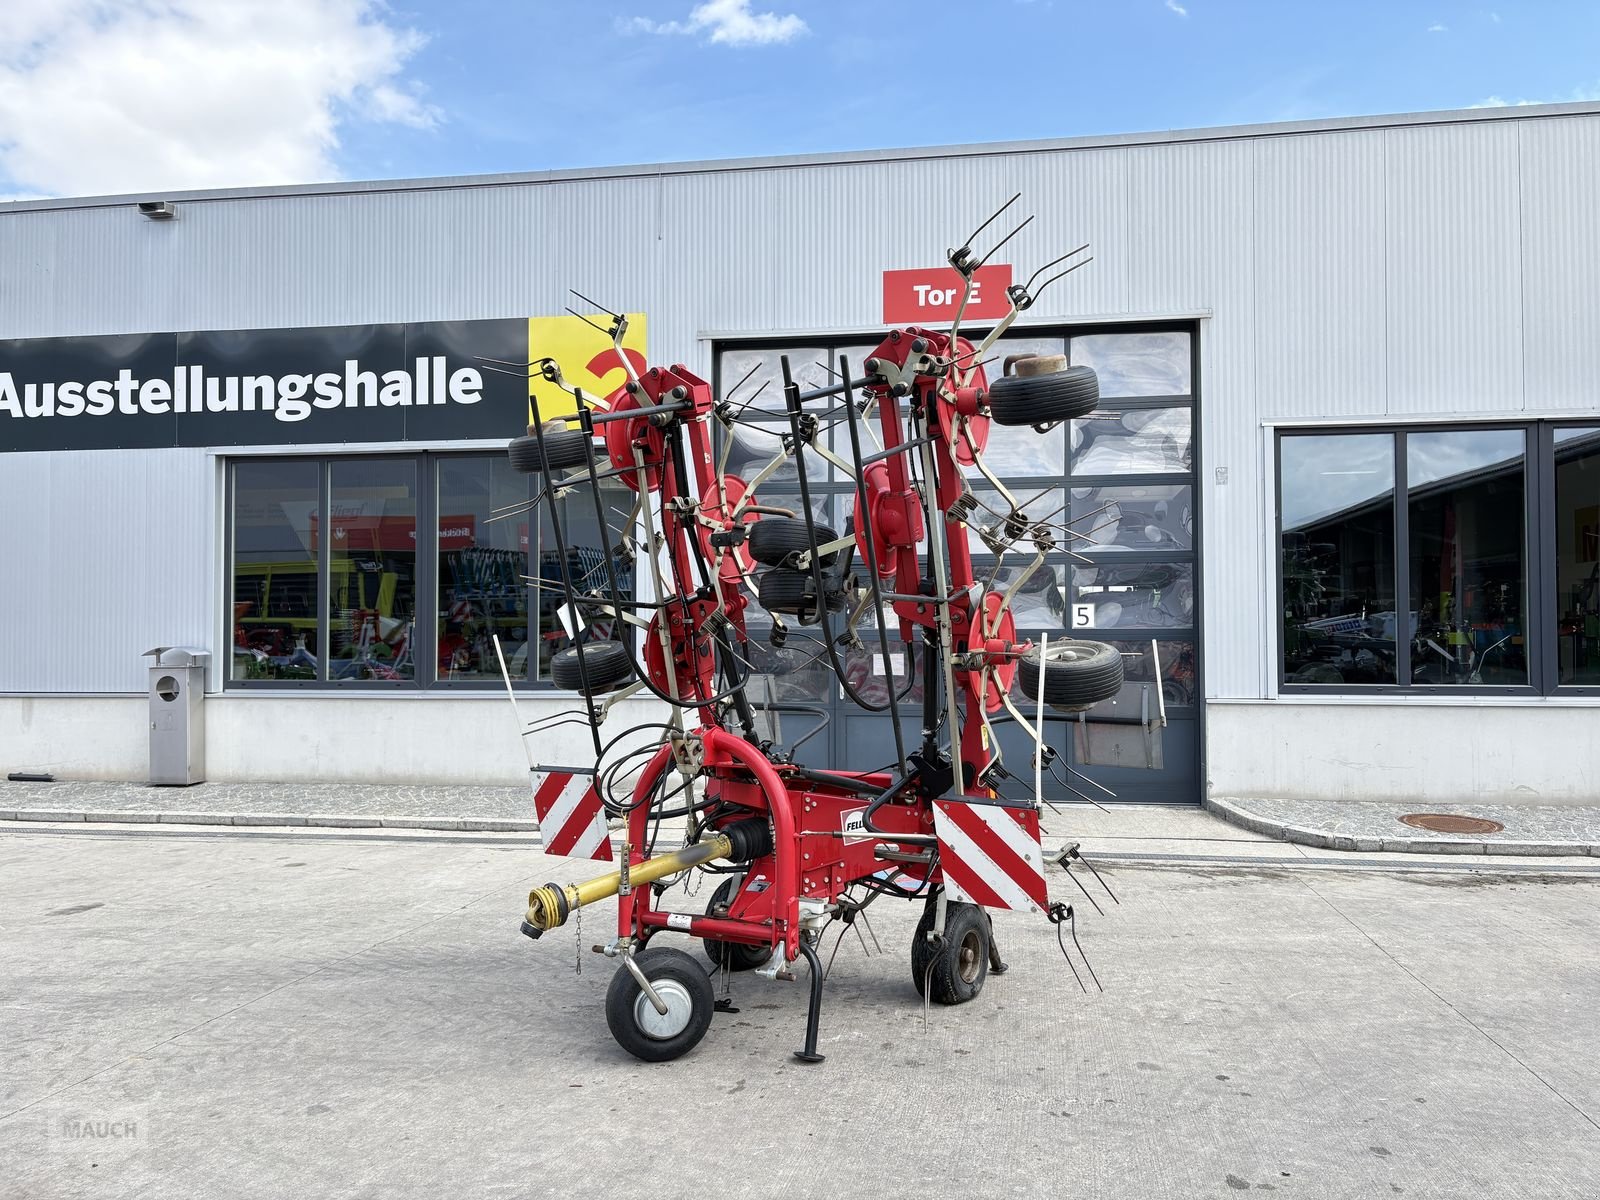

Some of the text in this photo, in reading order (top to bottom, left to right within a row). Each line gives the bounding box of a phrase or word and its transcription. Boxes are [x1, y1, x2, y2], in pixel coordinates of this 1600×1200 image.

[913, 284, 957, 306] Tor
[0, 356, 483, 422] Ausstellungshalle
[1077, 607, 1089, 626] 5
[847, 820, 863, 831] FELL
